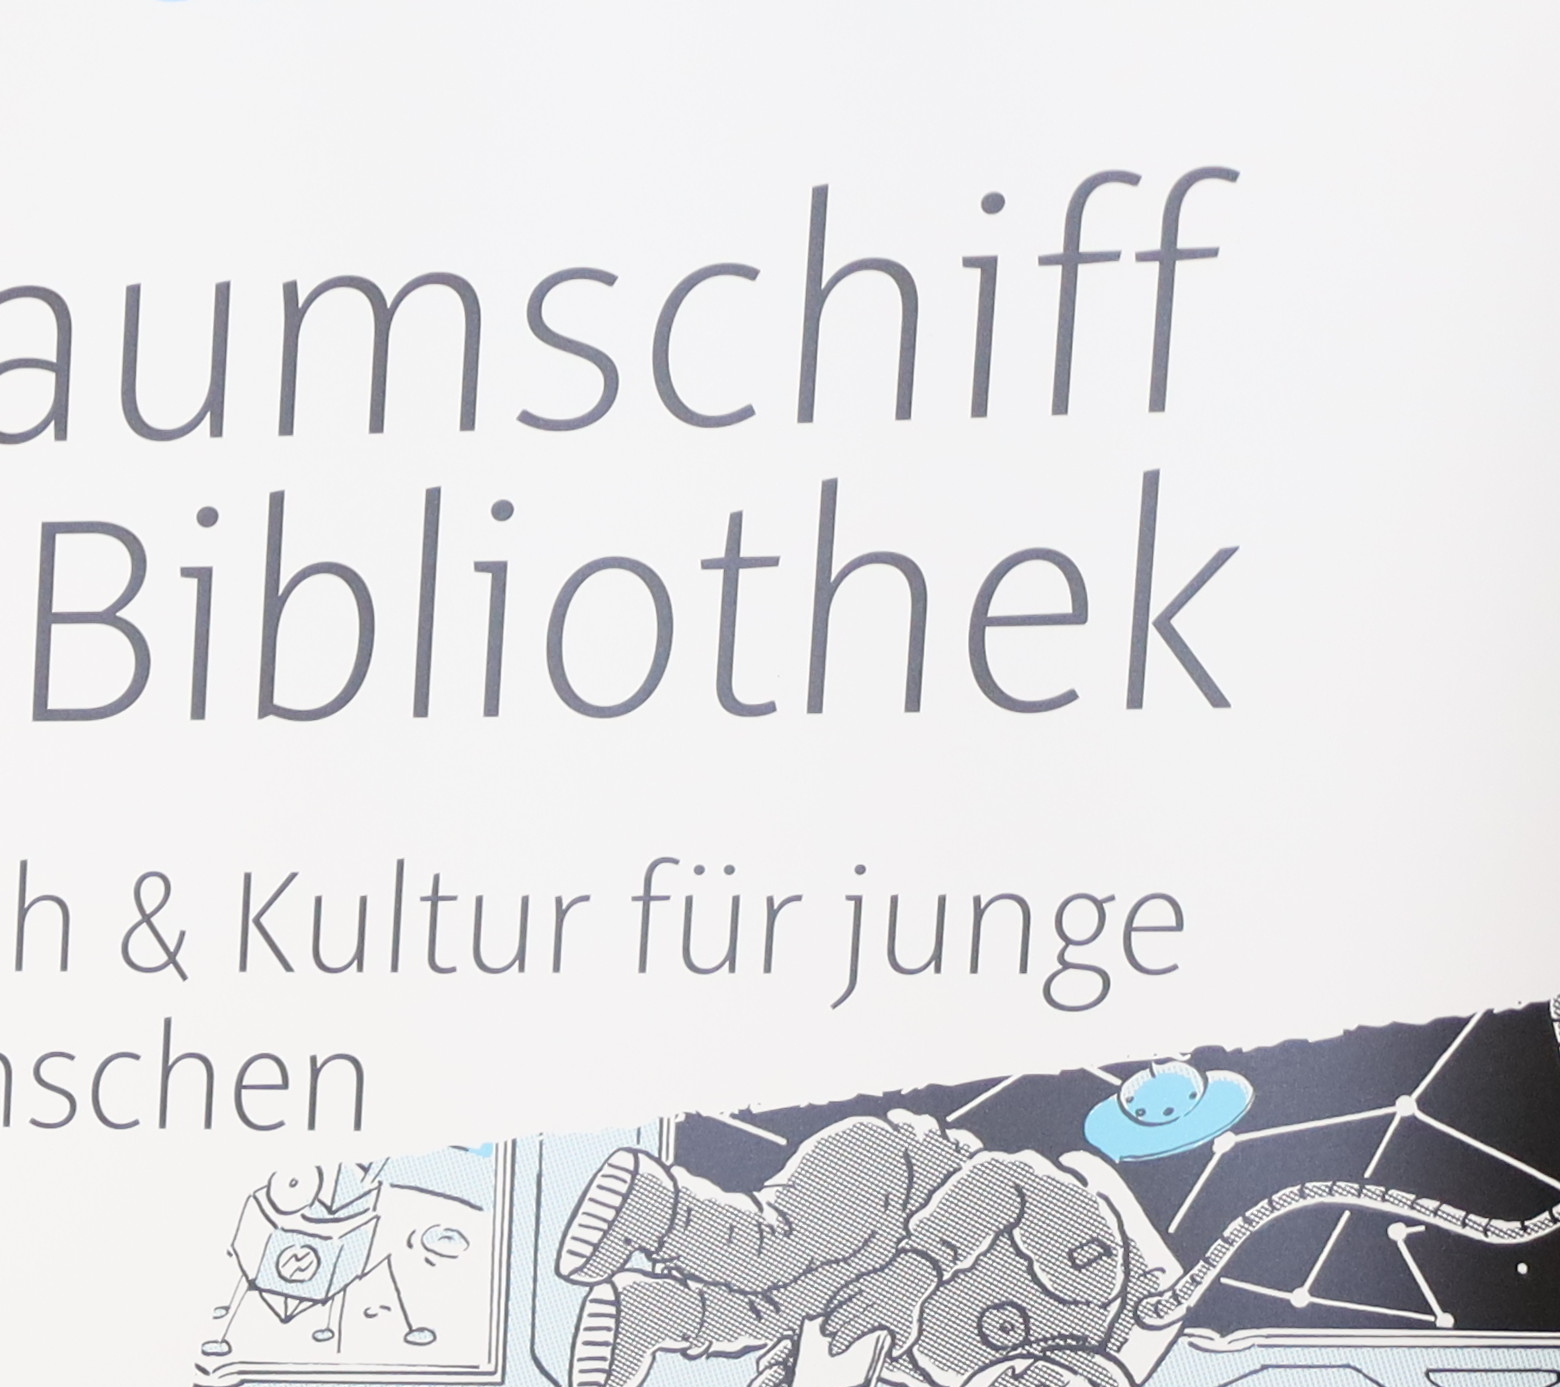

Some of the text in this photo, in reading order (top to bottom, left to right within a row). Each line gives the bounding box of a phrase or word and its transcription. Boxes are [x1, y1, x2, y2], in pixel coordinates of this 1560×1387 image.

[29, 468, 1241, 724] Bibliothek
[121, 870, 190, 982] &
[235, 858, 590, 975] Kultur
[632, 856, 796, 975] für
[830, 864, 1186, 1012] junge
